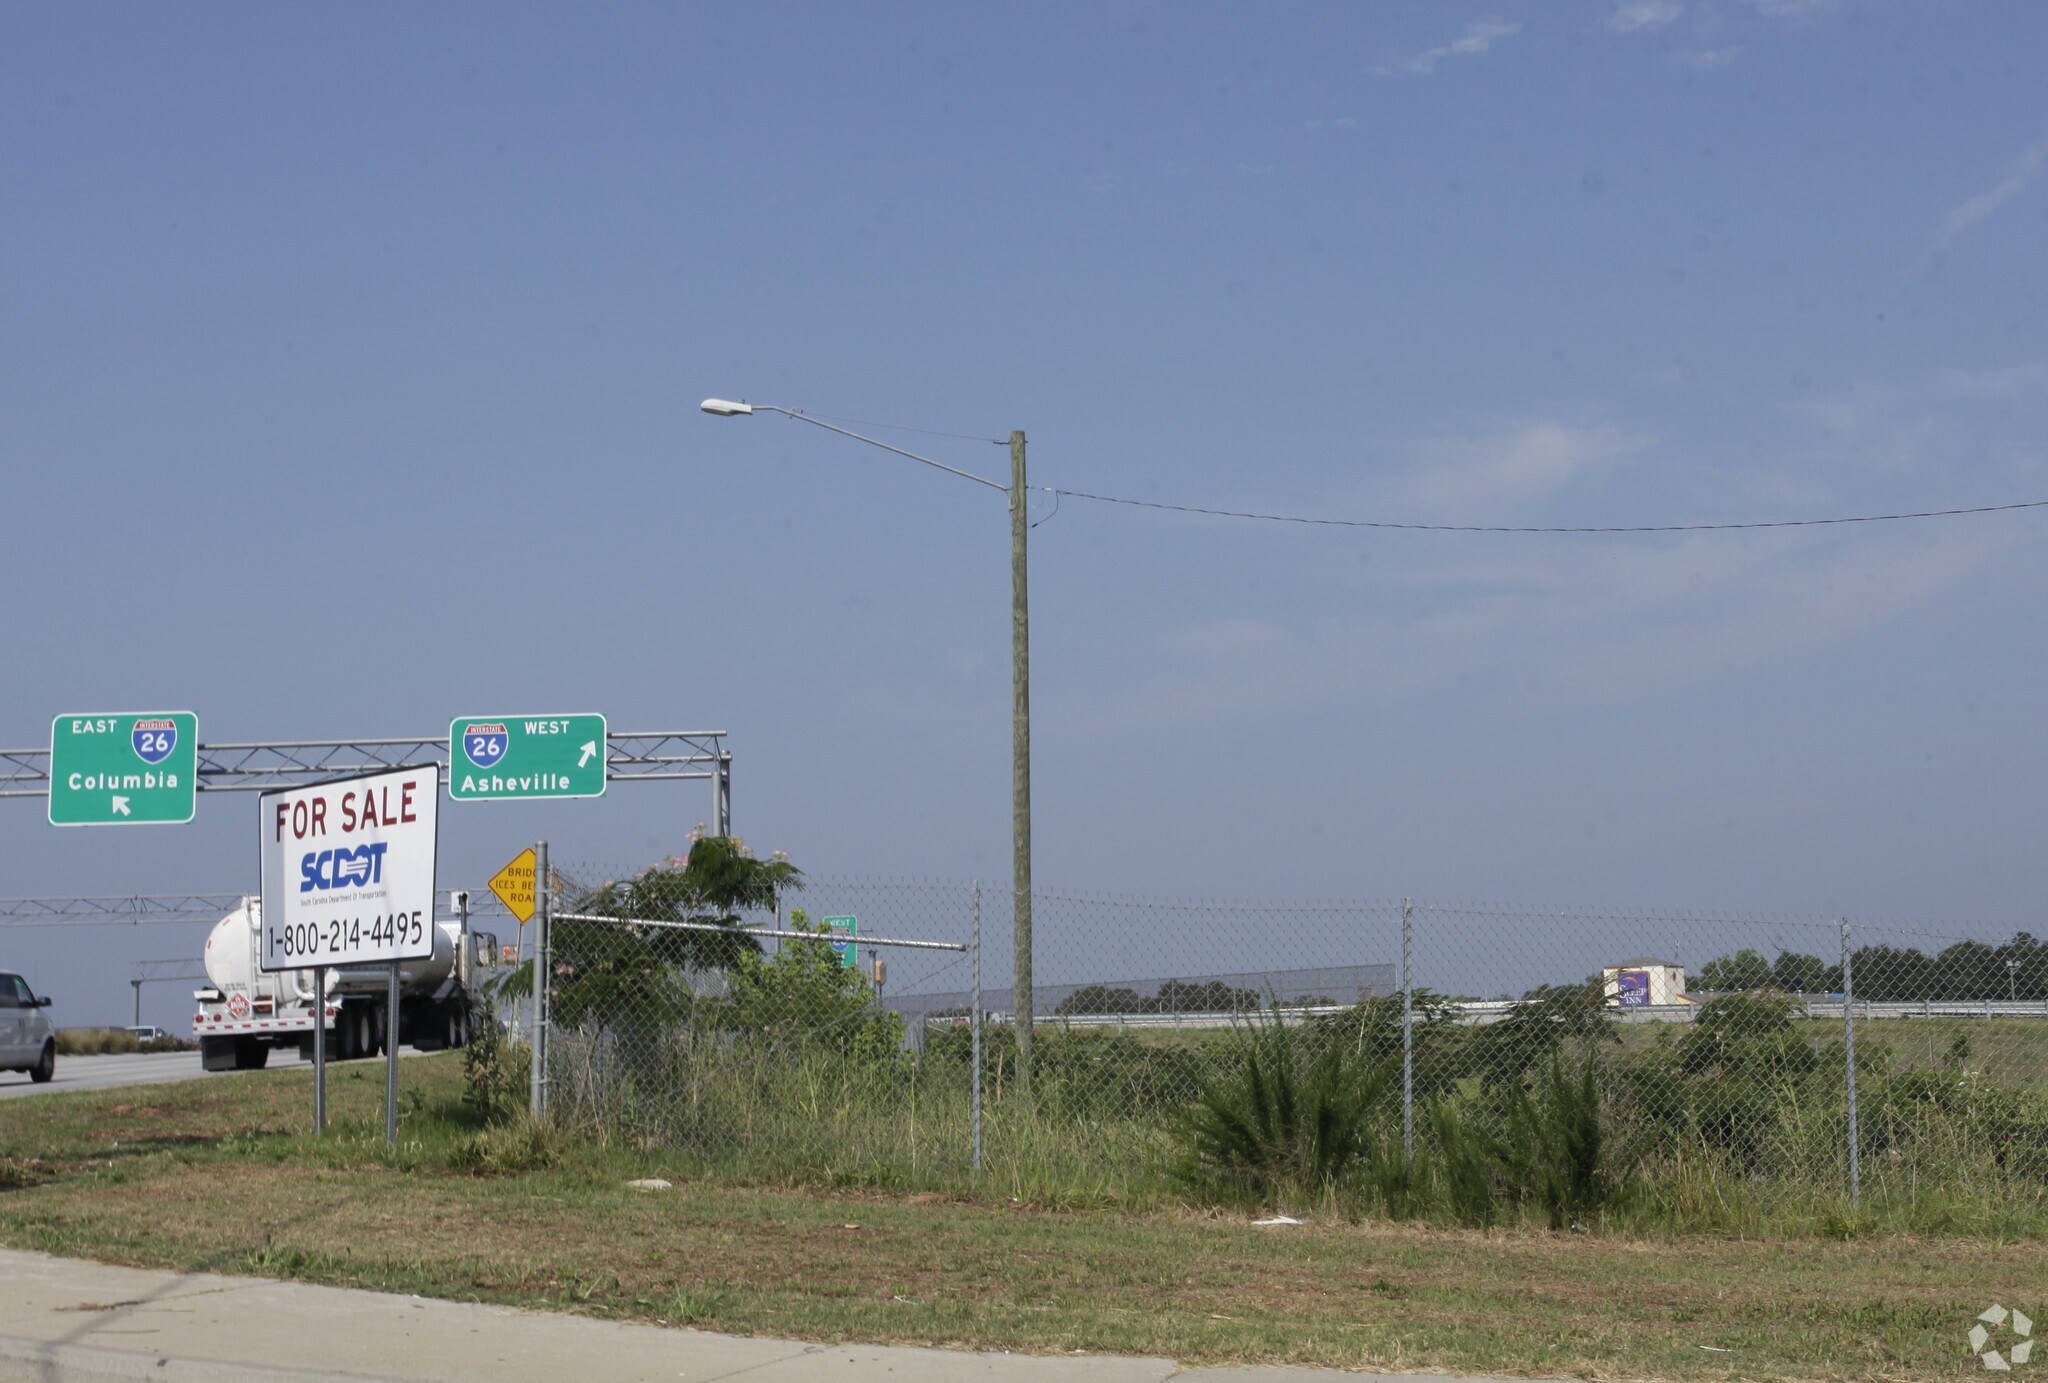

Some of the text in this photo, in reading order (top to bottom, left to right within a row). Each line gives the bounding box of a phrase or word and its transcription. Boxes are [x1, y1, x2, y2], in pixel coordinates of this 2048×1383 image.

[72, 719, 117, 734] EAST
[139, 721, 171, 729] INTERSTATE
[524, 720, 570, 735] WEST
[141, 732, 169, 752] 26
[472, 737, 500, 756] 26
[68, 771, 178, 791] Columbia
[460, 773, 570, 792] Asheville
[276, 781, 417, 843] FOR SALE
[300, 841, 388, 893] SCDOT
[495, 880, 515, 890] ICES
[300, 898, 312, 907] South
[312, 896, 328, 906] Carolina
[328, 894, 352, 904] Department
[358, 890, 387, 900] Transportation
[269, 911, 423, 958] 1-800-214-4495
[1626, 996, 1642, 1004] INN
